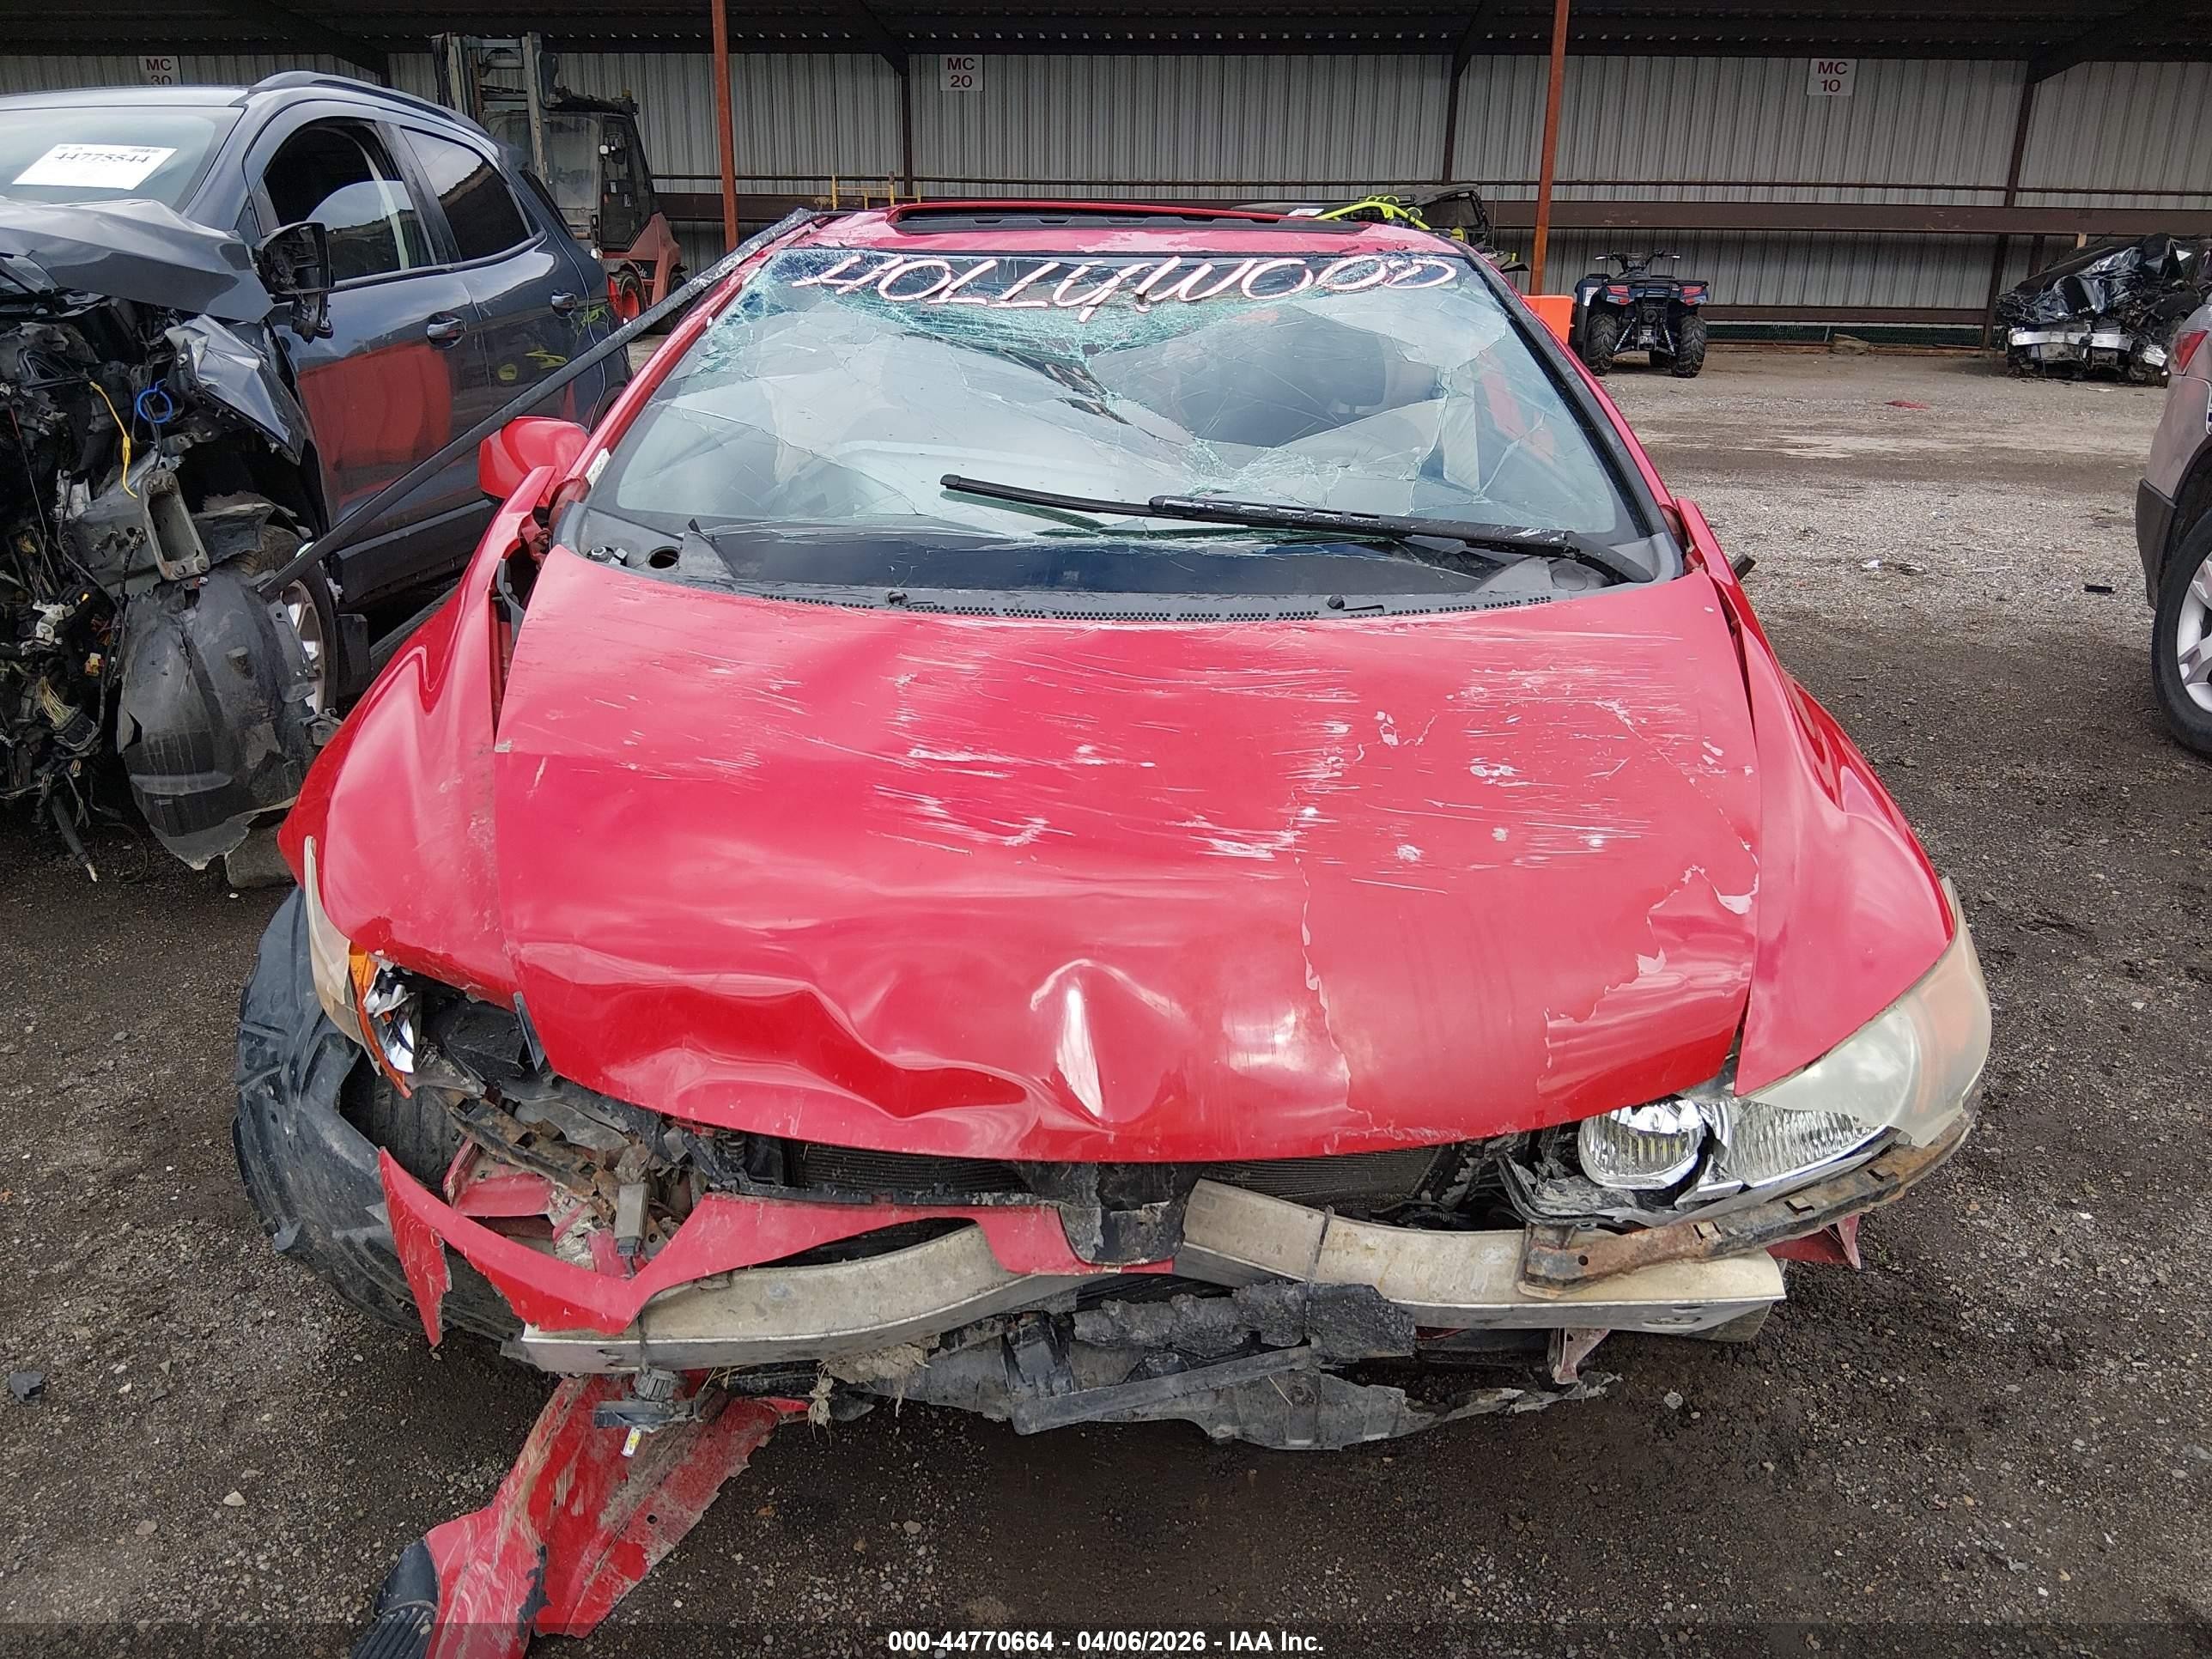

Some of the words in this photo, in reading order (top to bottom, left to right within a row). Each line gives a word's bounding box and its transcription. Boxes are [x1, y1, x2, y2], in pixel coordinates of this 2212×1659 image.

[146, 58, 172, 70] MC
[947, 57, 975, 70] MC
[1818, 61, 1848, 75] MC
[150, 75, 172, 85] 30
[951, 75, 972, 88] 20
[1820, 79, 1841, 92] 10
[791, 255, 1457, 323] HOLLYWOOD
